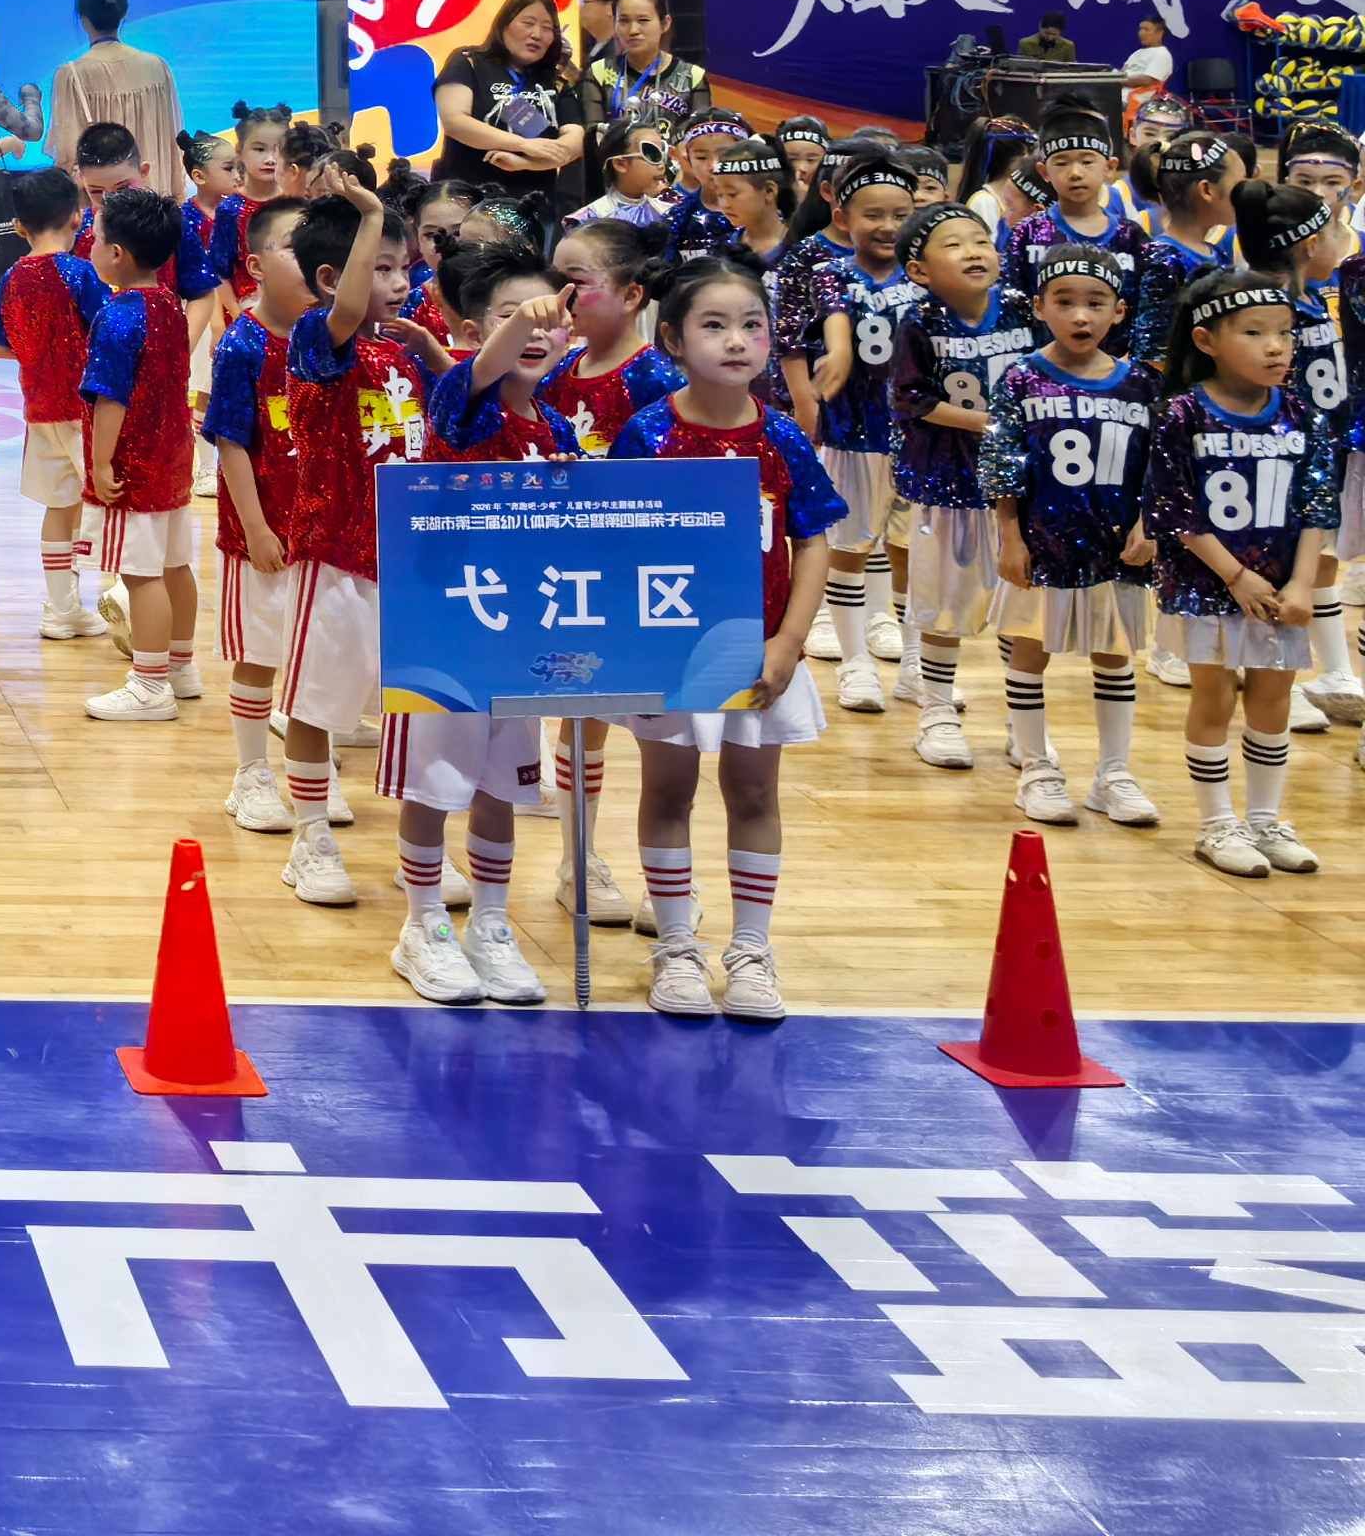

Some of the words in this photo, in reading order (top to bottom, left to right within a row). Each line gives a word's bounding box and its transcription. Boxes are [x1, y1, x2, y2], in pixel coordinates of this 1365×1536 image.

[1225, 288, 1279, 309] LOVE
[1021, 396, 1073, 424] THE
[444, 564, 701, 632] 弋江区
